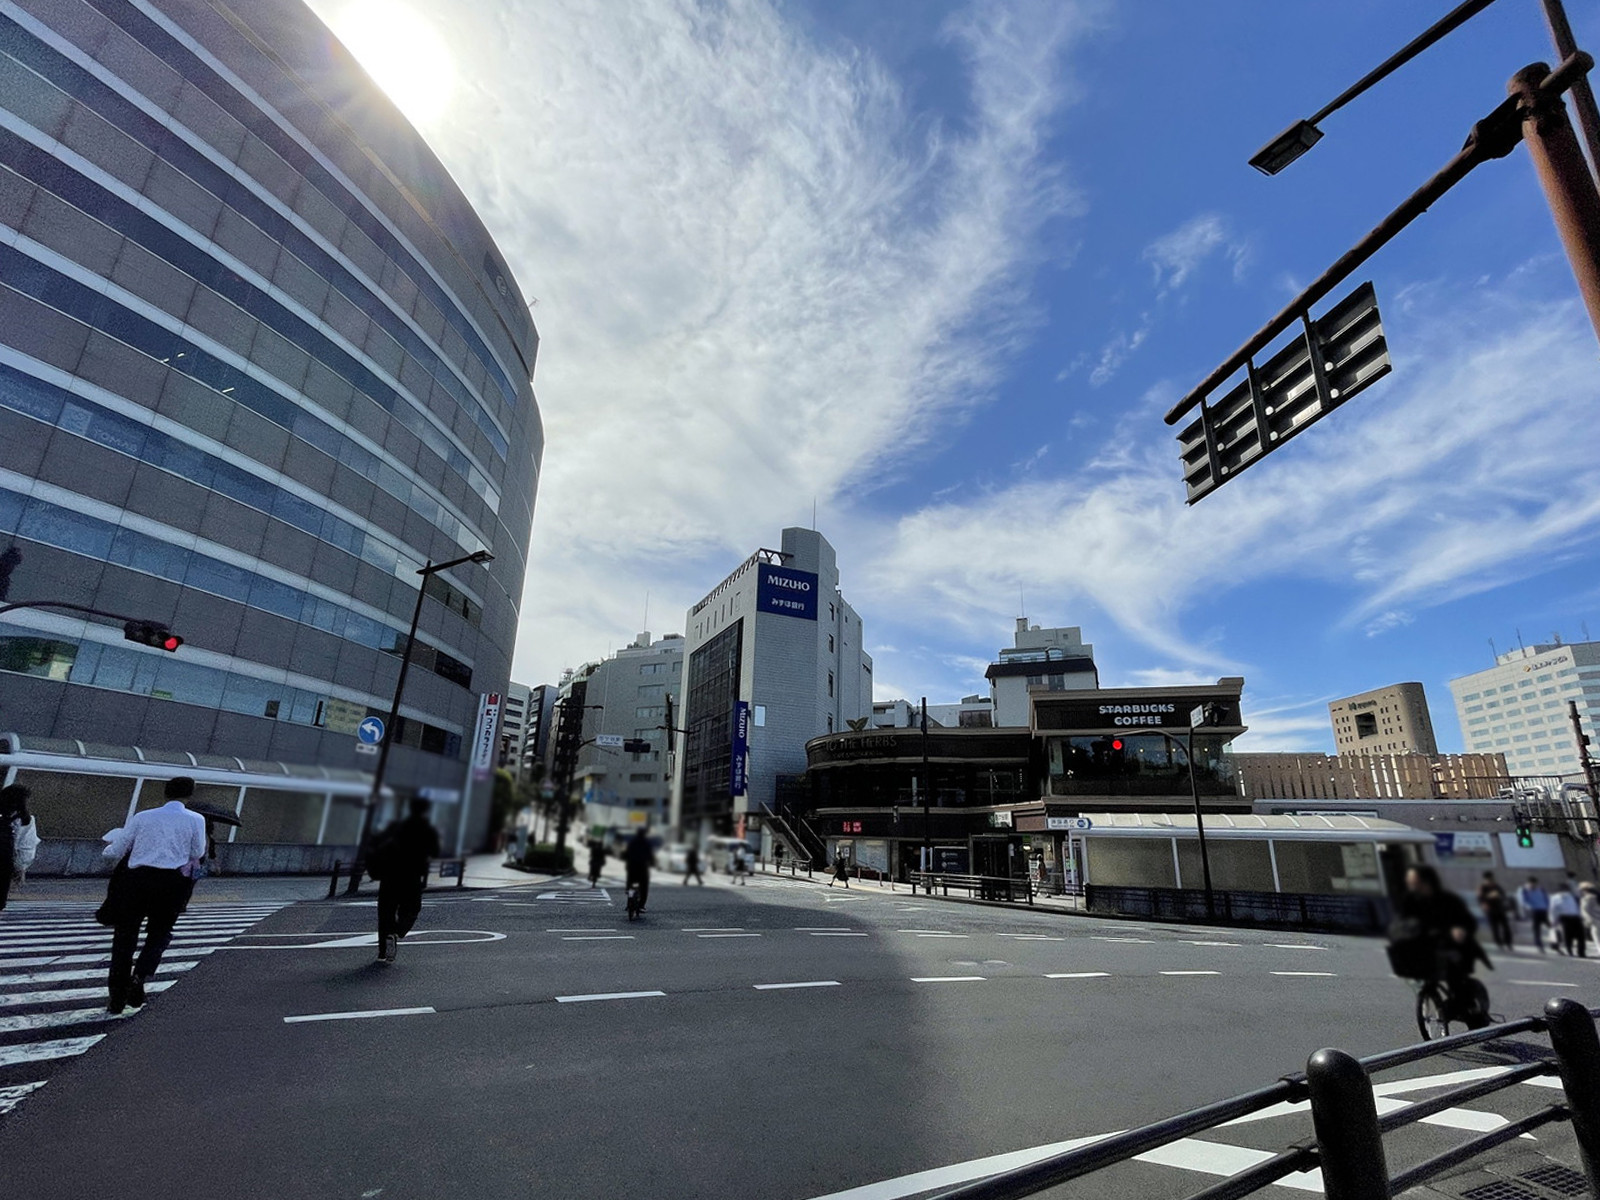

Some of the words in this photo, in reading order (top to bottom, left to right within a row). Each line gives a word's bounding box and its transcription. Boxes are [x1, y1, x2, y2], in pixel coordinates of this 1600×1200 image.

[767, 574, 810, 591] MIZUHO
[771, 598, 805, 611] みずほ銀行
[1098, 703, 1175, 714] STARBUCKS
[738, 707, 747, 738] MIZUHO
[1114, 716, 1162, 726] COFFEE
[861, 735, 897, 748] HERBS
